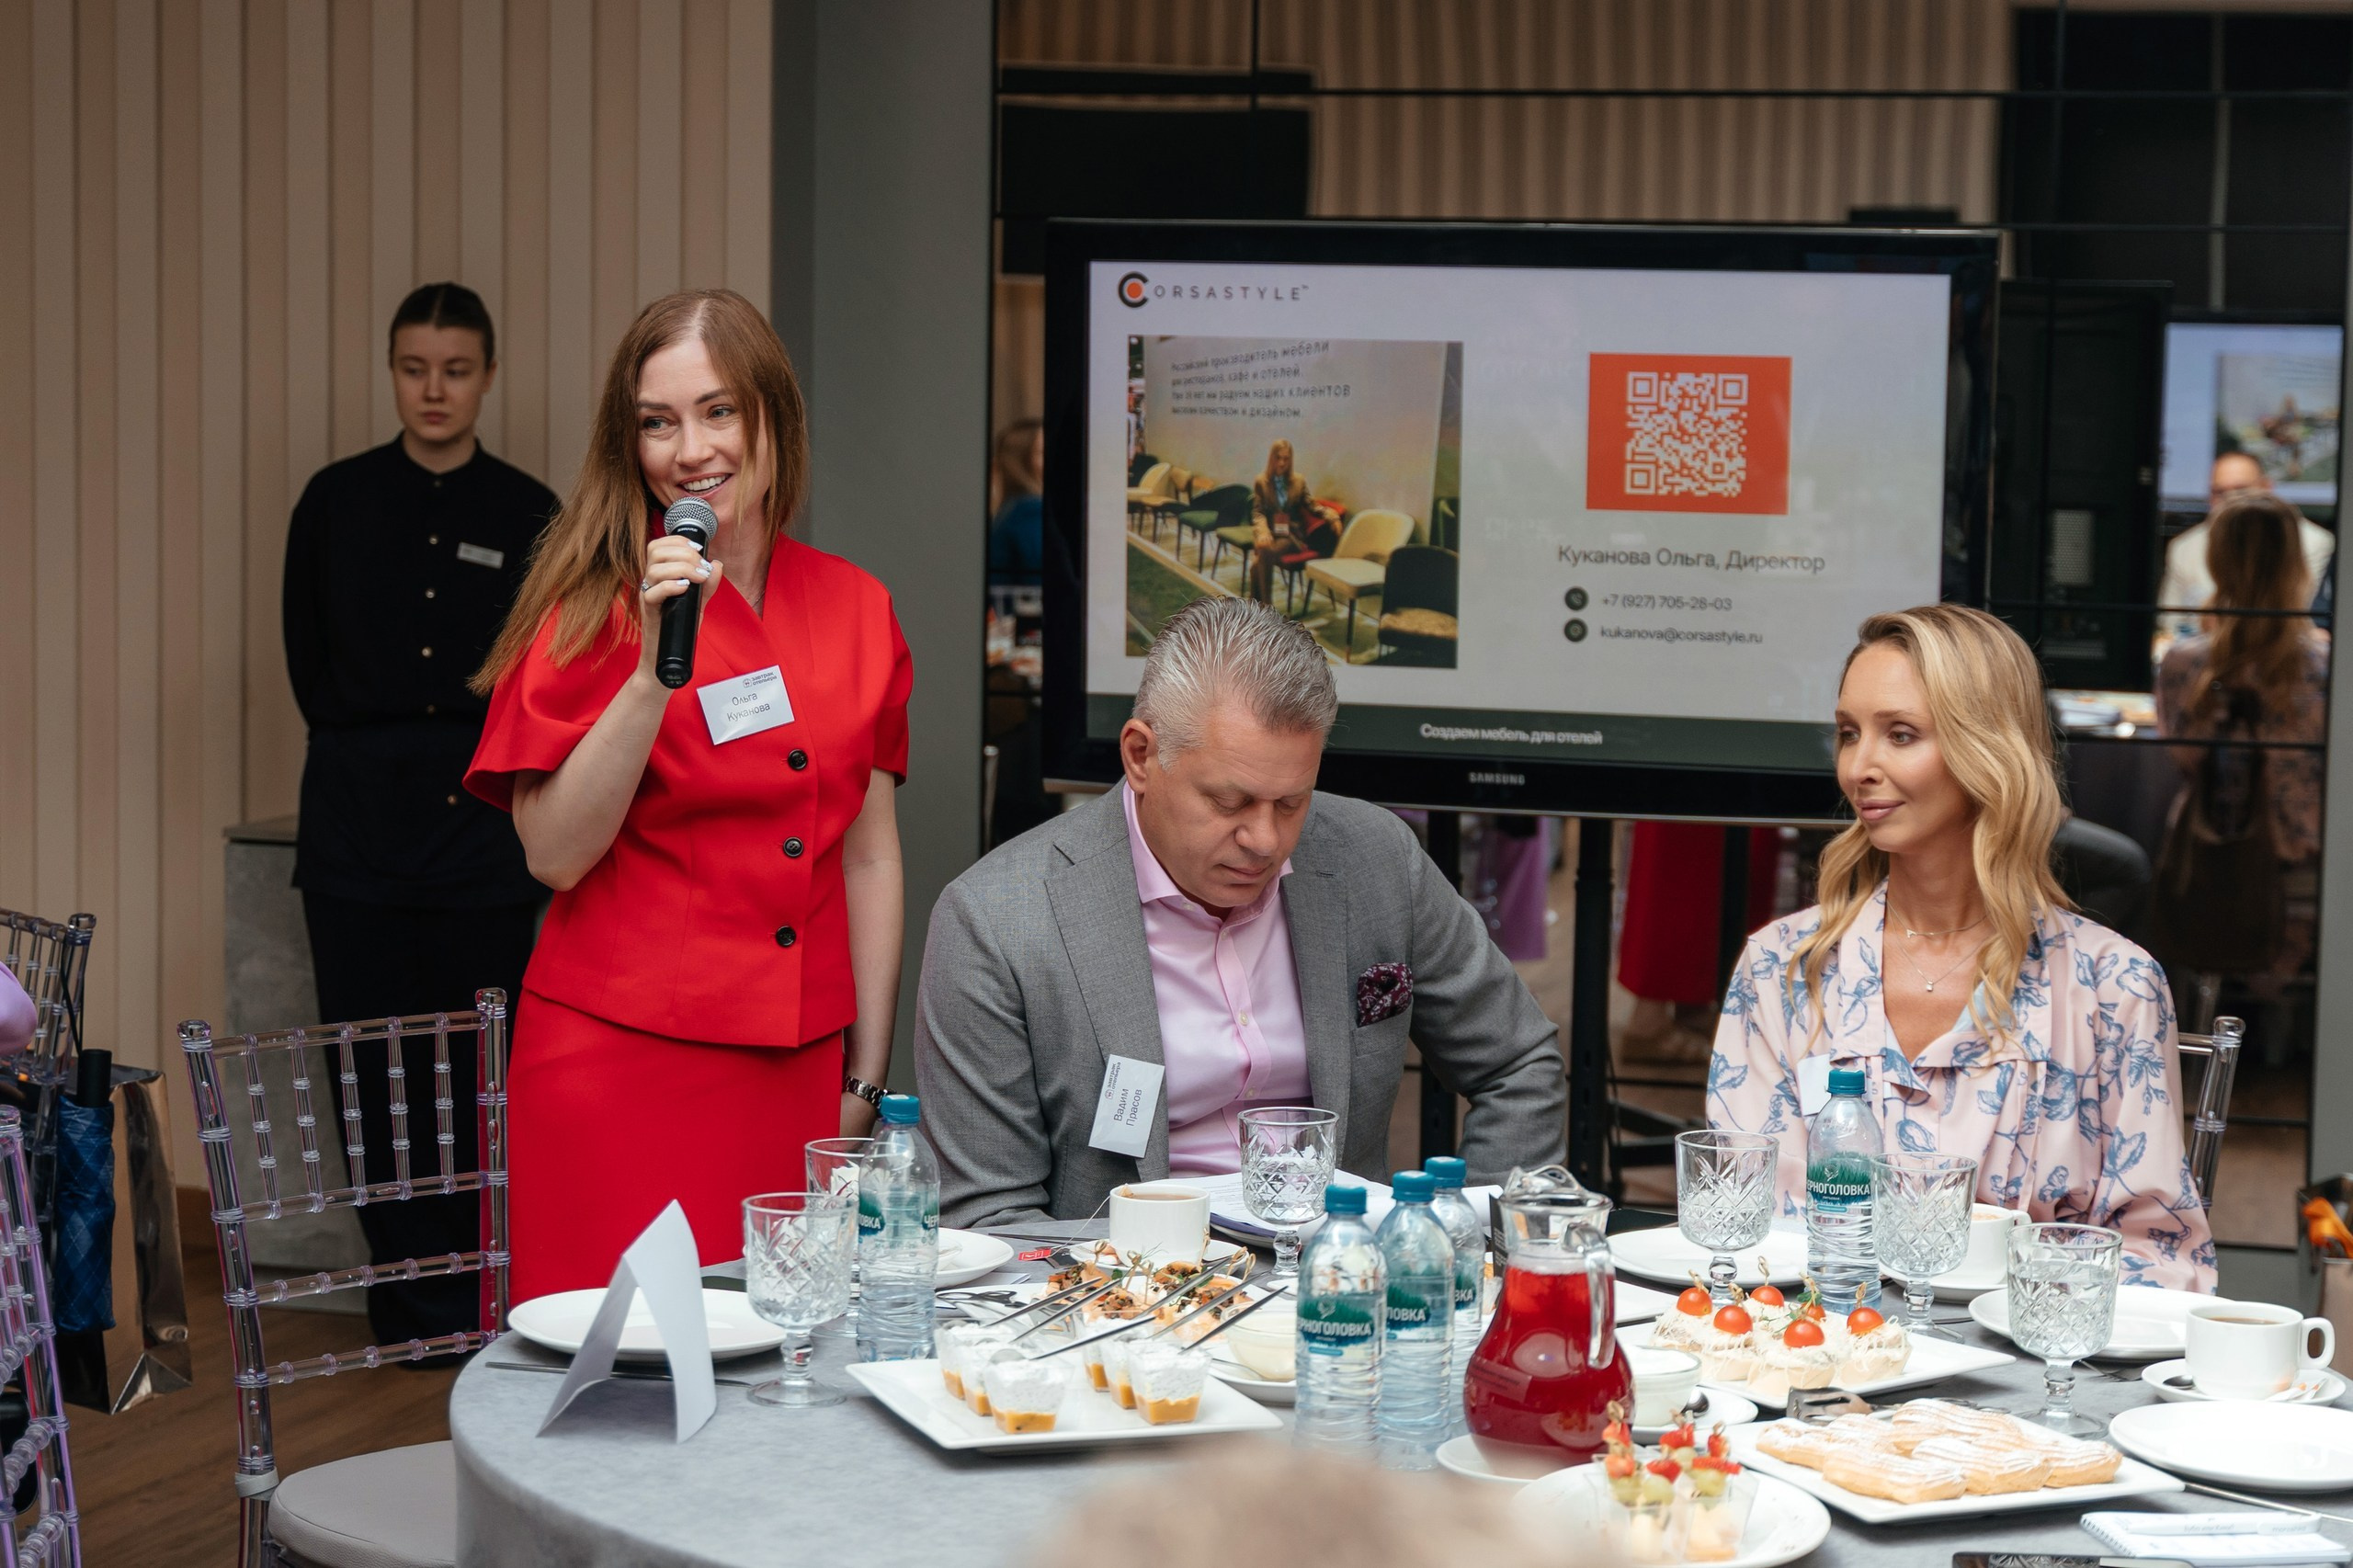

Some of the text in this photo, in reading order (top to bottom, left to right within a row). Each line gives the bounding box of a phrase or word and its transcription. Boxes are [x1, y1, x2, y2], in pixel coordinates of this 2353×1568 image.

[1558, 546, 1825, 575] Куканова Ольга, Директор
[1602, 595, 1733, 611] +7 (927) 705-28-03
[1600, 625, 1763, 644] kukanova@corsastyle.ru
[732, 692, 758, 706] Ольга
[726, 703, 770, 722] Куканова
[1420, 723, 1603, 745] Создаем мебель для отелей
[1468, 772, 1526, 786] SAMSUNG
[1113, 1088, 1130, 1122] Вадим
[1125, 1089, 1142, 1127] Прасов
